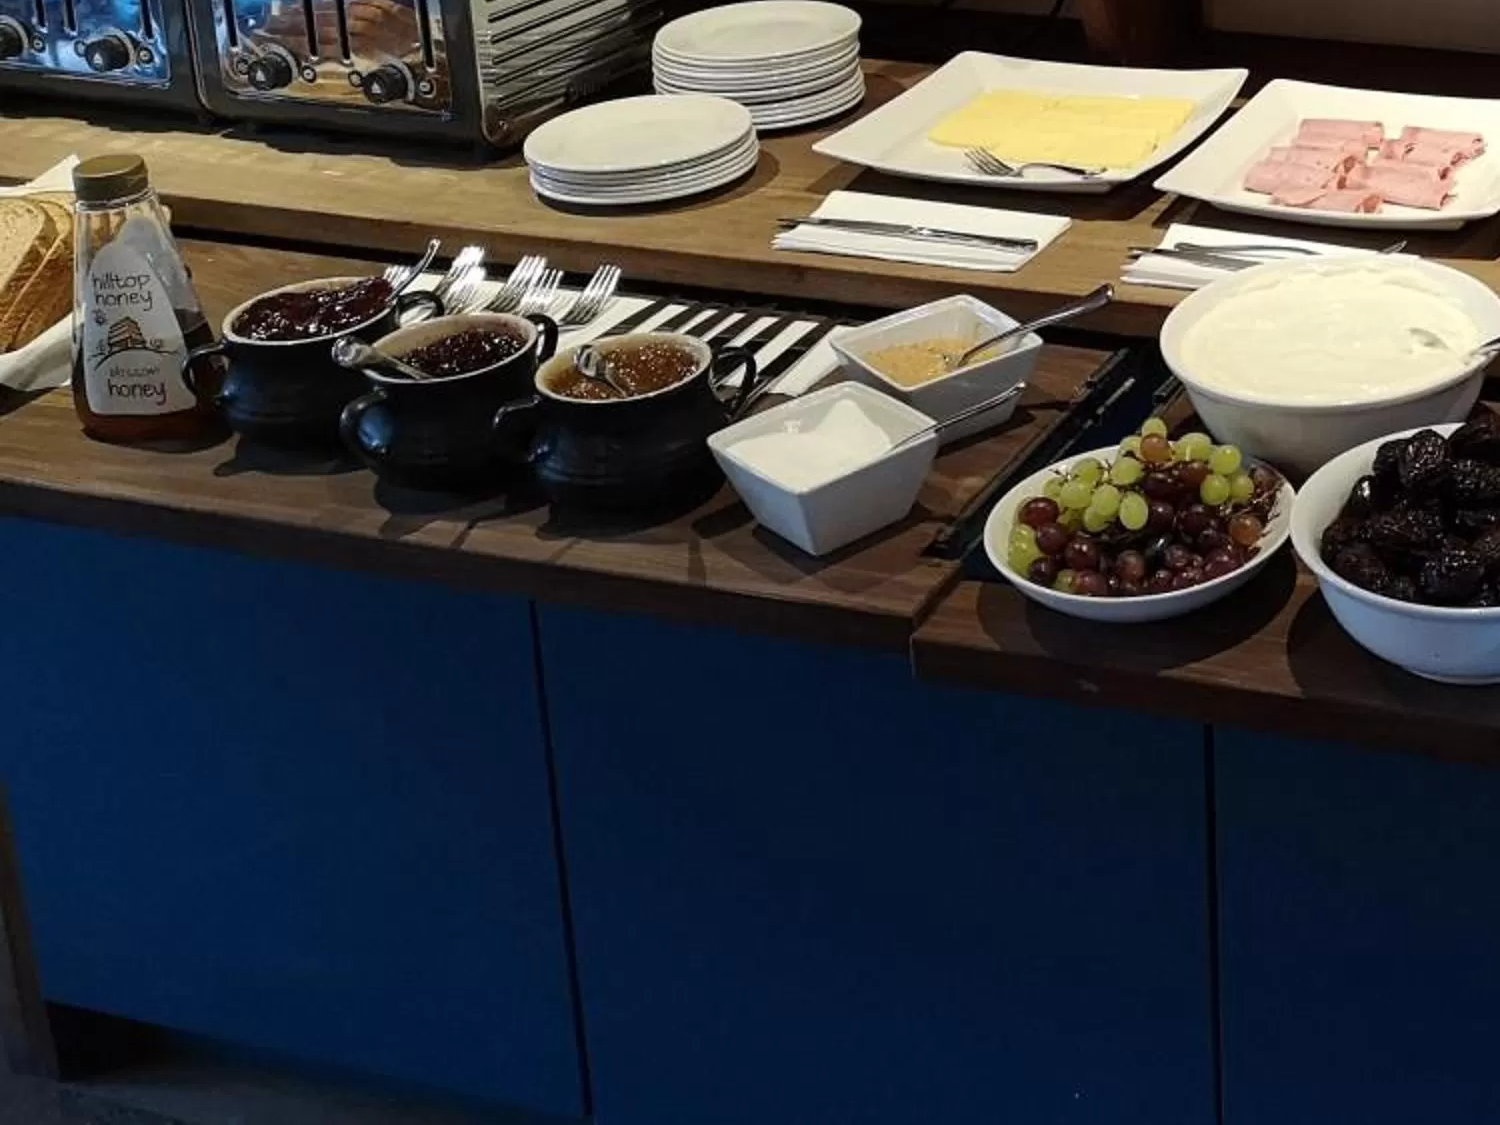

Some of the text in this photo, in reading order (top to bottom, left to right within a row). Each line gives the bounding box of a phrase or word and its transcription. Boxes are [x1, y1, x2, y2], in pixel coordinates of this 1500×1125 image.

[92, 271, 151, 290] hilltop
[95, 291, 152, 312] honey
[107, 378, 167, 406] honey
